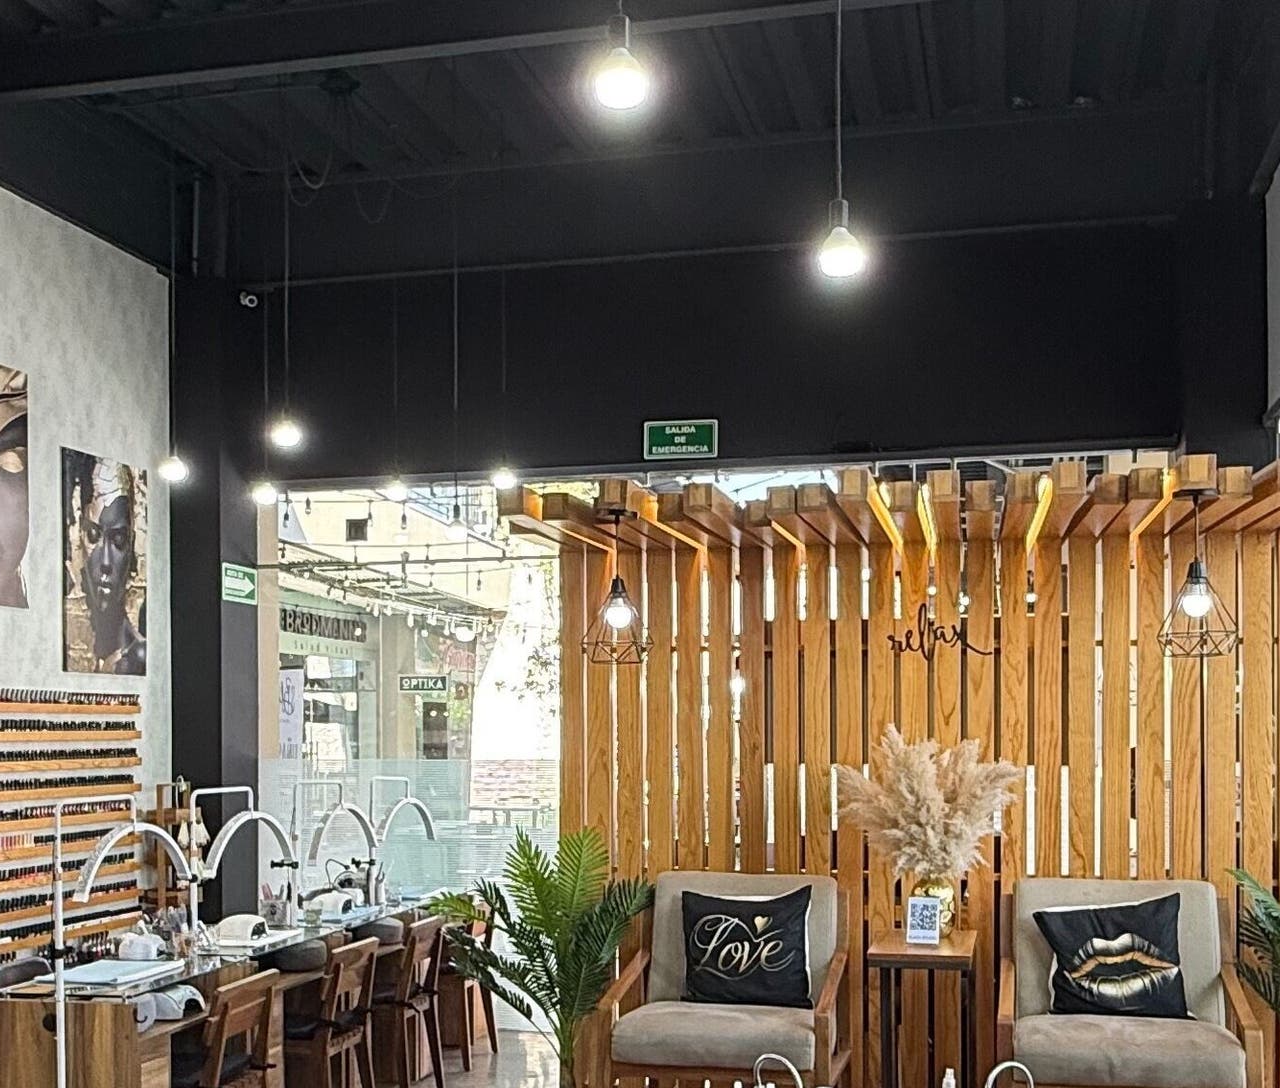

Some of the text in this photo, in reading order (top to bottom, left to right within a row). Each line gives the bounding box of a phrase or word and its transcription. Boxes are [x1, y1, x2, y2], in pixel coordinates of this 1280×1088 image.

[665, 426, 696, 434] SALIDA
[652, 445, 709, 454] EMERGENCIA
[887, 603, 993, 661] relax
[402, 677, 444, 689] OPTIKA
[689, 914, 796, 981] Love
